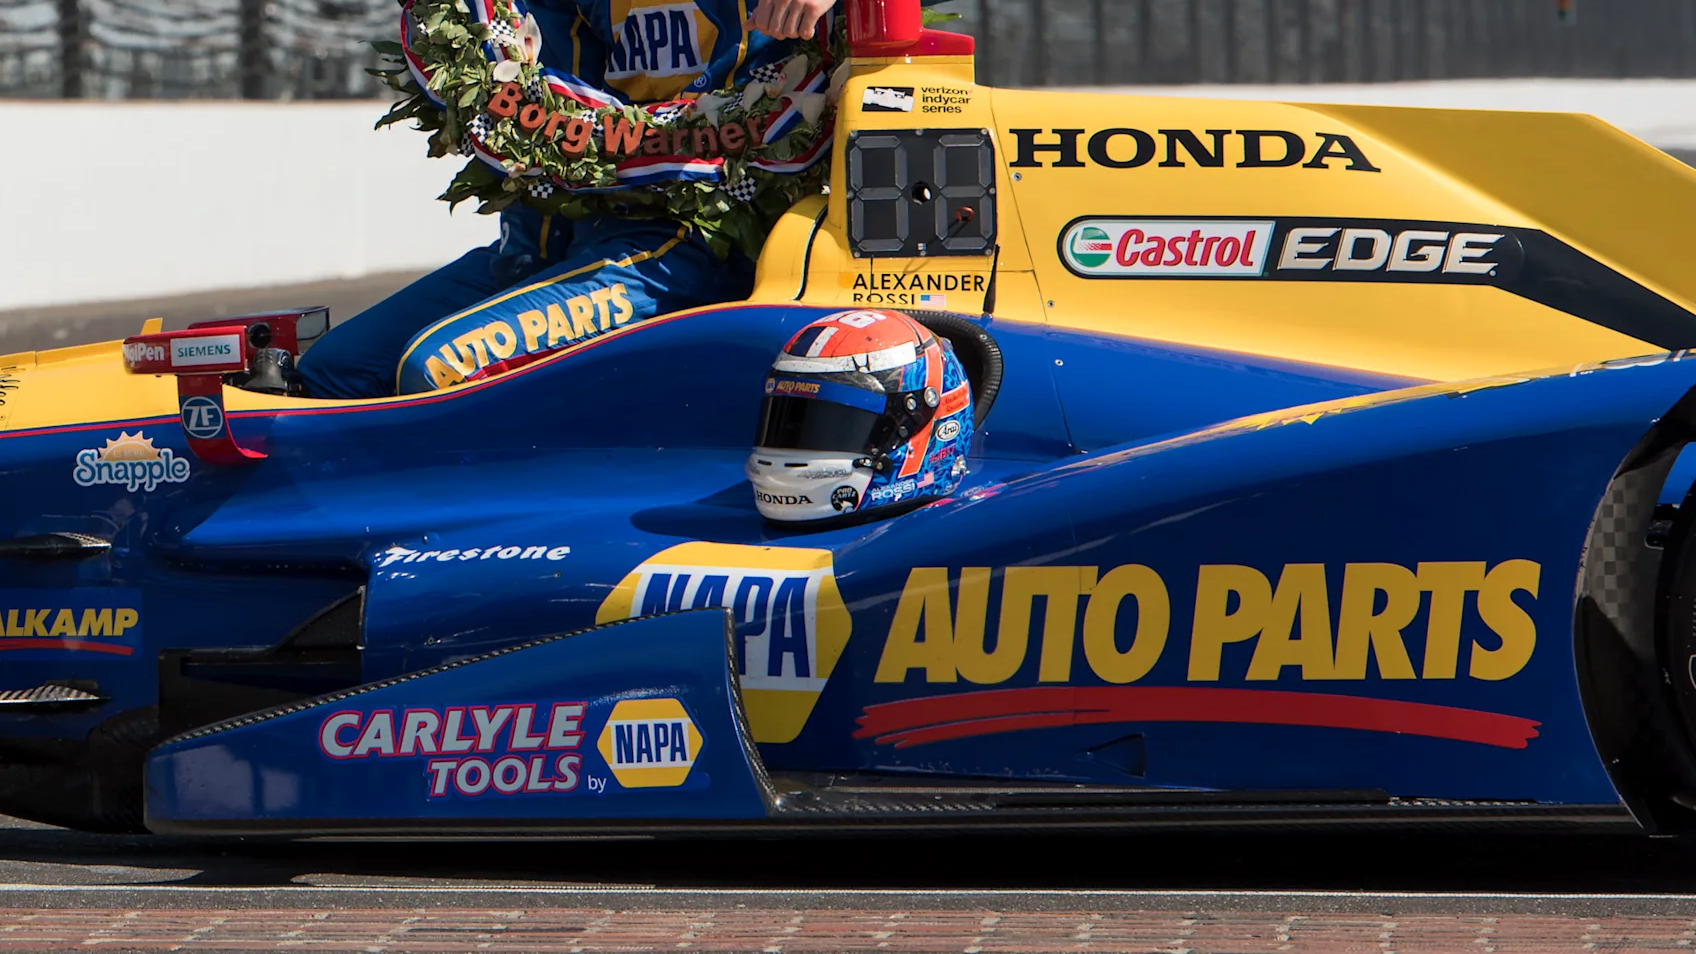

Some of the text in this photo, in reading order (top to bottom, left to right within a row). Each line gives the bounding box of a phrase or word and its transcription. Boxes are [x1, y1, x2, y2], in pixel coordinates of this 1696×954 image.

[920, 86, 970, 96] verizon
[922, 95, 971, 105] indycar
[487, 81, 767, 159] Borg Warner
[922, 104, 962, 114] series
[1008, 127, 1382, 173] HONDA
[1115, 225, 1505, 275] Castrol EDGE
[853, 273, 984, 292] ALEXANDER
[853, 293, 915, 305] ROSSI
[424, 283, 634, 390] AUTO PARTS
[177, 344, 231, 358] SIEMENS
[795, 381, 820, 393] PARTS
[188, 405, 214, 430] ZF
[74, 448, 190, 492] Snapple
[756, 490, 814, 505] HONDA
[871, 484, 915, 501] ROSSI
[379, 545, 571, 567] Firestone
[873, 558, 1540, 684] AUTO PARTS
[318, 701, 588, 759] CARLYLE
[615, 722, 687, 764] NAPA
[427, 753, 583, 797] TOOLS
[587, 775, 607, 794] by
